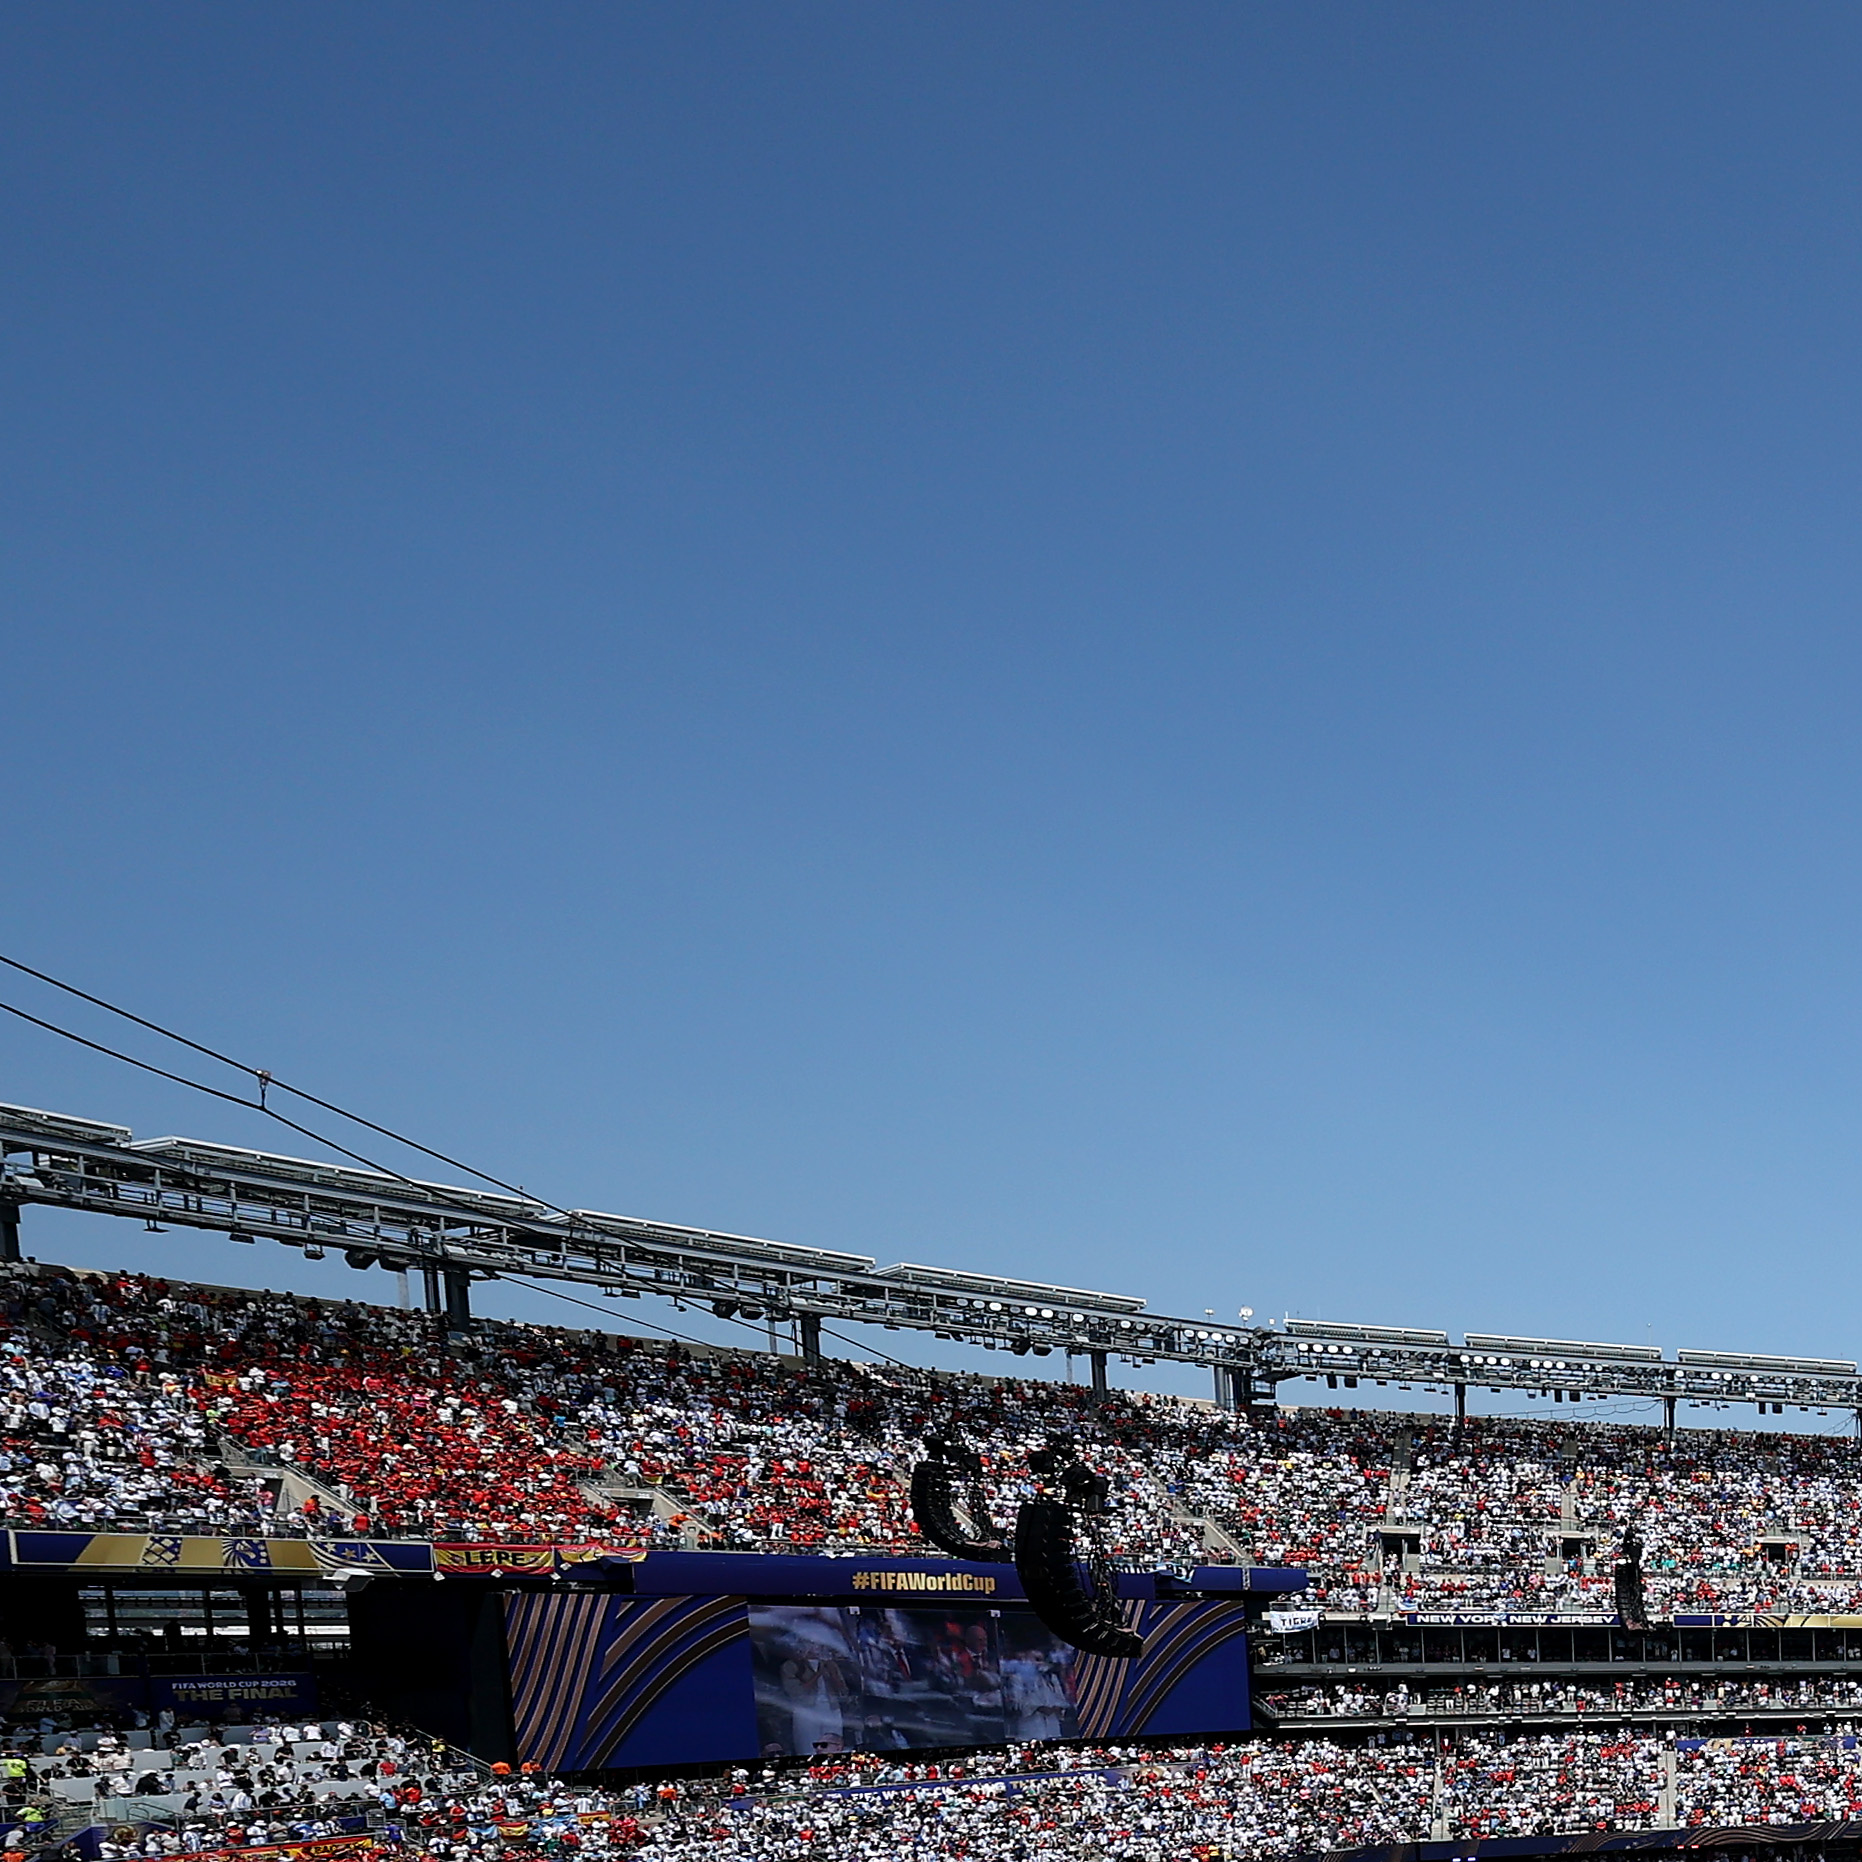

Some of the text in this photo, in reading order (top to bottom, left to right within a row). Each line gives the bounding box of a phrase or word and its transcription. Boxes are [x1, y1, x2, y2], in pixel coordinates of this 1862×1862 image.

[466, 1551, 525, 1566] LEPE
[852, 1572, 996, 1594] #FIFAWorldCup
[1416, 1615, 1614, 1624] NEW YOR NEW JERSEY
[172, 1682, 196, 1690] FIFA
[197, 1681, 236, 1689] WORLD
[173, 1687, 299, 1702] THE FINAL
